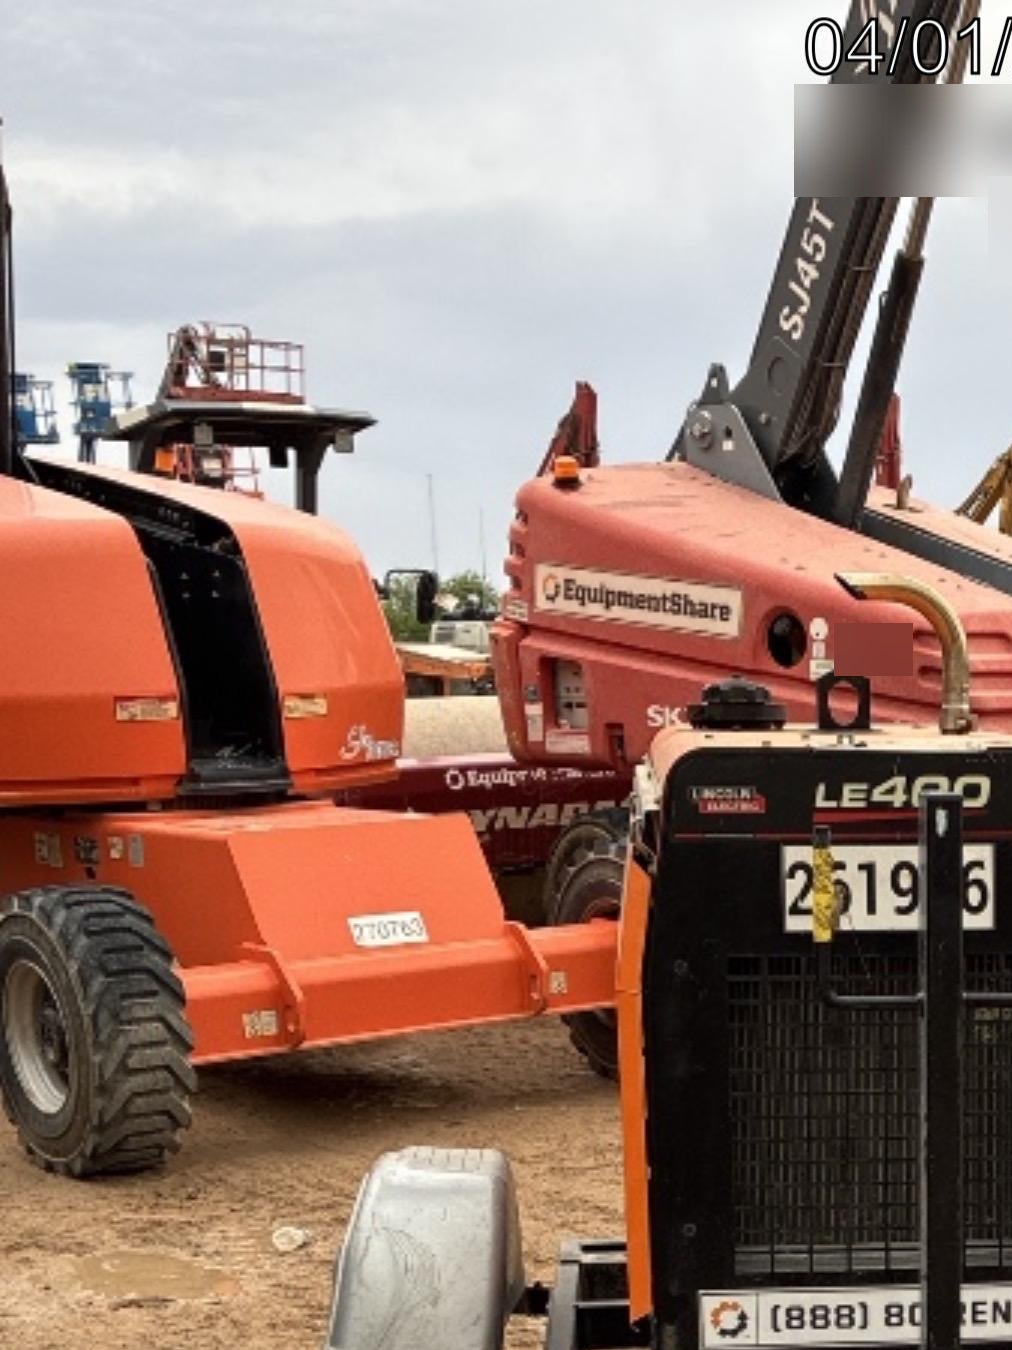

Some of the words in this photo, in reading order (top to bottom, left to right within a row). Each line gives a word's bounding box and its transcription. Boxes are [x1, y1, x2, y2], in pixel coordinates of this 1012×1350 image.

[780, 197, 835, 340] SJ45T
[563, 578, 732, 622] EquipmentShare
[815, 776, 991, 808] LE400
[770, 1302, 868, 1333] (888)
